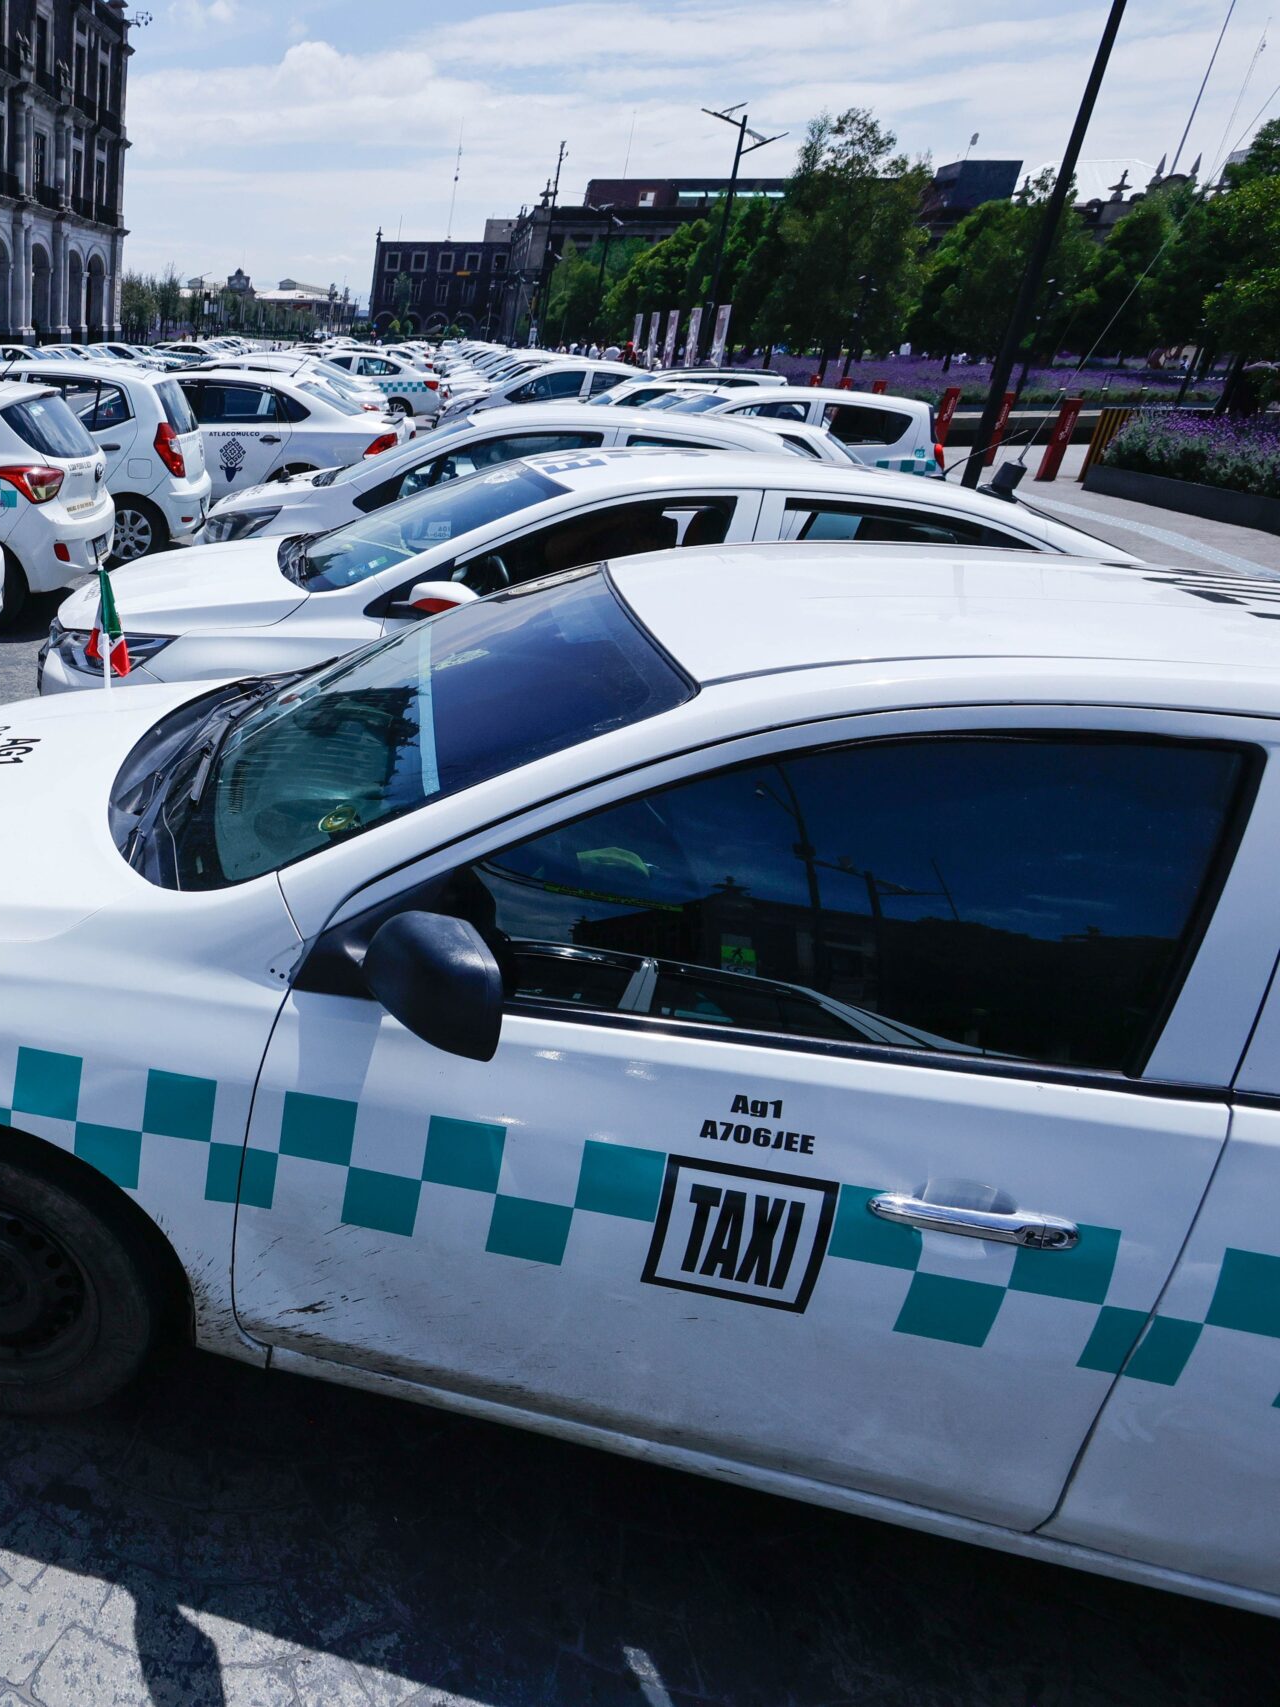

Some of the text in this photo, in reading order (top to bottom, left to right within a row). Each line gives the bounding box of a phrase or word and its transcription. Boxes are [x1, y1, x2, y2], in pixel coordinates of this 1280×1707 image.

[730, 1094, 783, 1119] Ag1
[700, 1119, 815, 1155] A706JEE
[680, 1183, 806, 1290] TAXI
